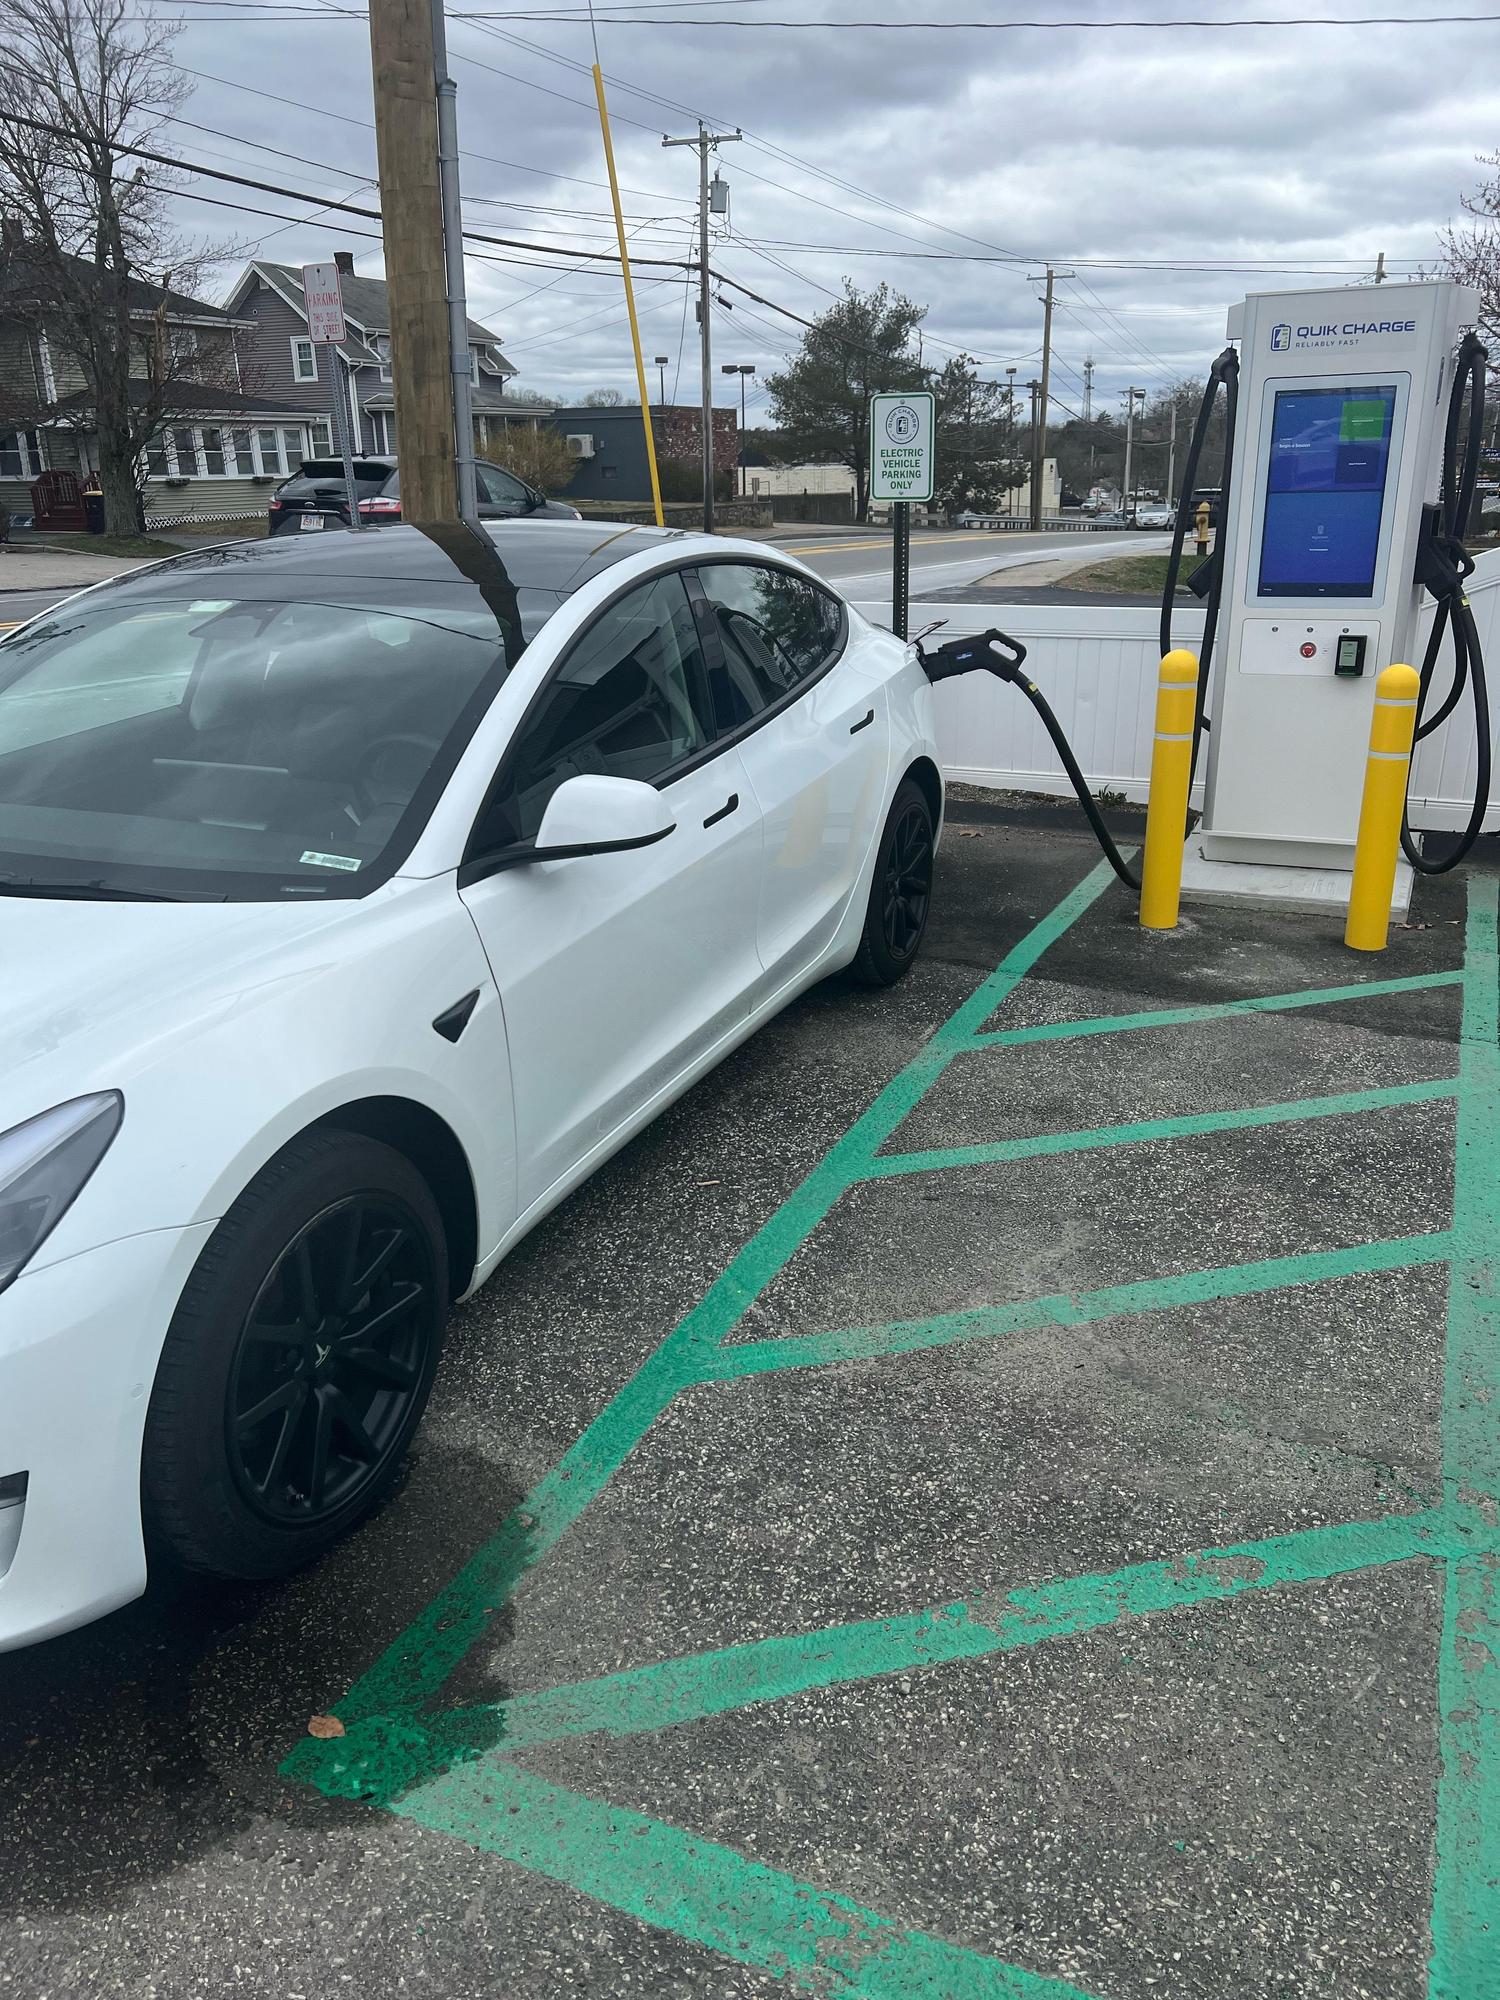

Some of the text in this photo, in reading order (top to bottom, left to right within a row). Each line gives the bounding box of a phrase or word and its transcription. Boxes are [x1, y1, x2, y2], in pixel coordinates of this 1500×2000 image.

[308, 292, 339, 308] PARKING
[323, 324, 340, 335] STREET
[1296, 321, 1416, 339] QUIK CHARGE
[1295, 340, 1335, 348] RELIABLY
[897, 408, 917, 429] CHARGE
[880, 448, 924, 458] ELECTRIC
[883, 459, 921, 468] VEHICLE
[881, 470, 922, 479] PARKING
[890, 480, 913, 489] ONLY
